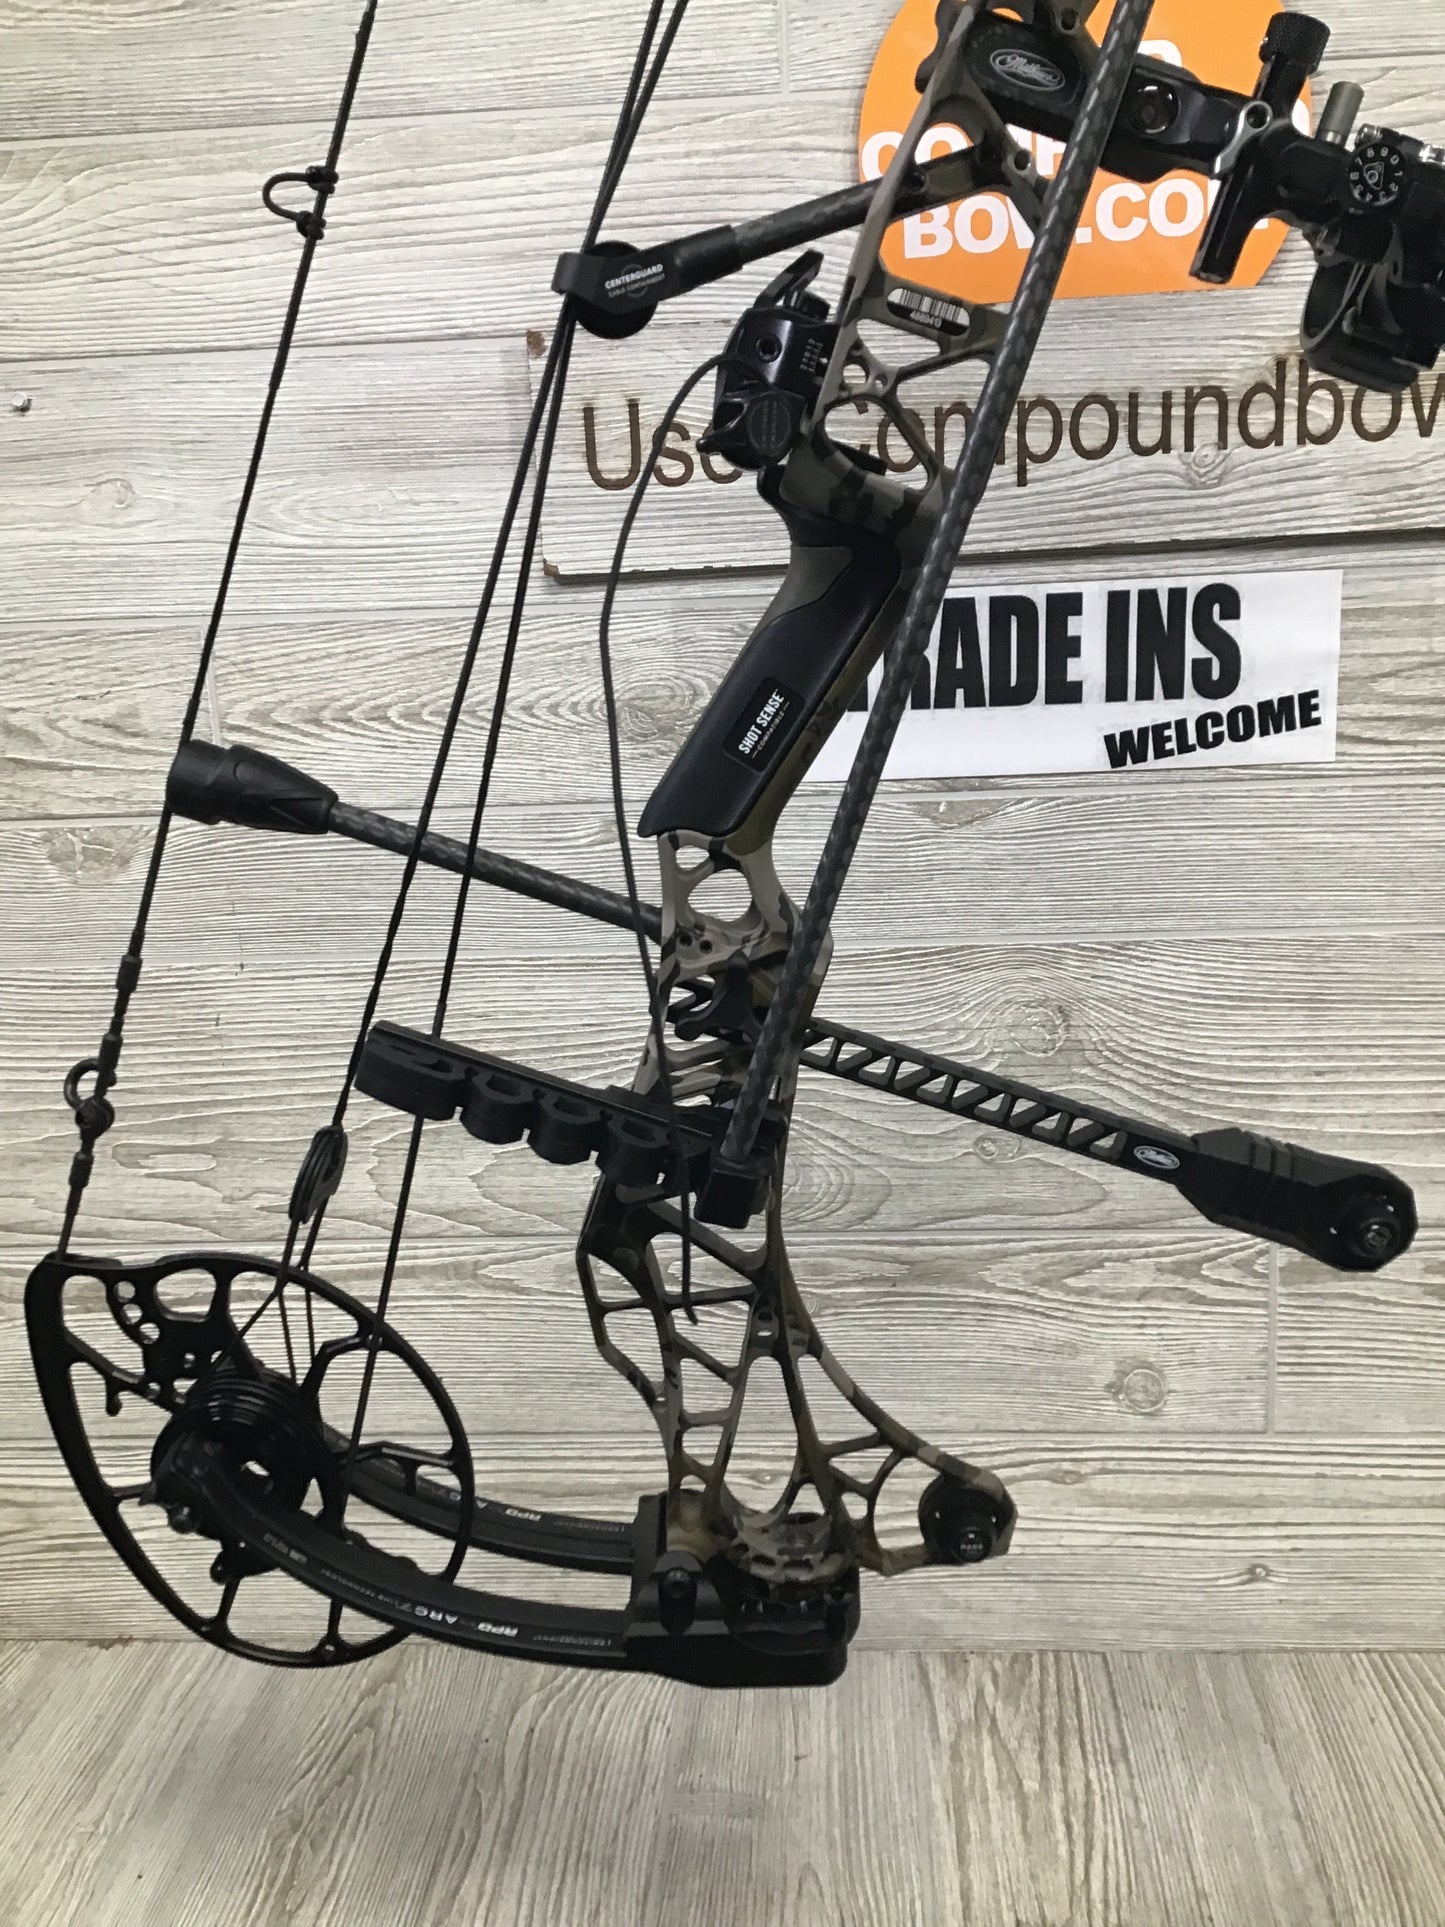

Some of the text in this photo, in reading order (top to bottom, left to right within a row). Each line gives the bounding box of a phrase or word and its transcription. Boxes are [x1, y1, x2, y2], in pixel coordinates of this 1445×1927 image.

[903, 177, 1271, 259] BO.CO
[604, 263, 664, 289] CENTERGUARD
[848, 582, 1242, 712] ADE INS
[738, 690, 784, 754] SHOT SENSE
[757, 711, 785, 750] COMPATIBLE
[1104, 689, 1322, 770] WELCOME
